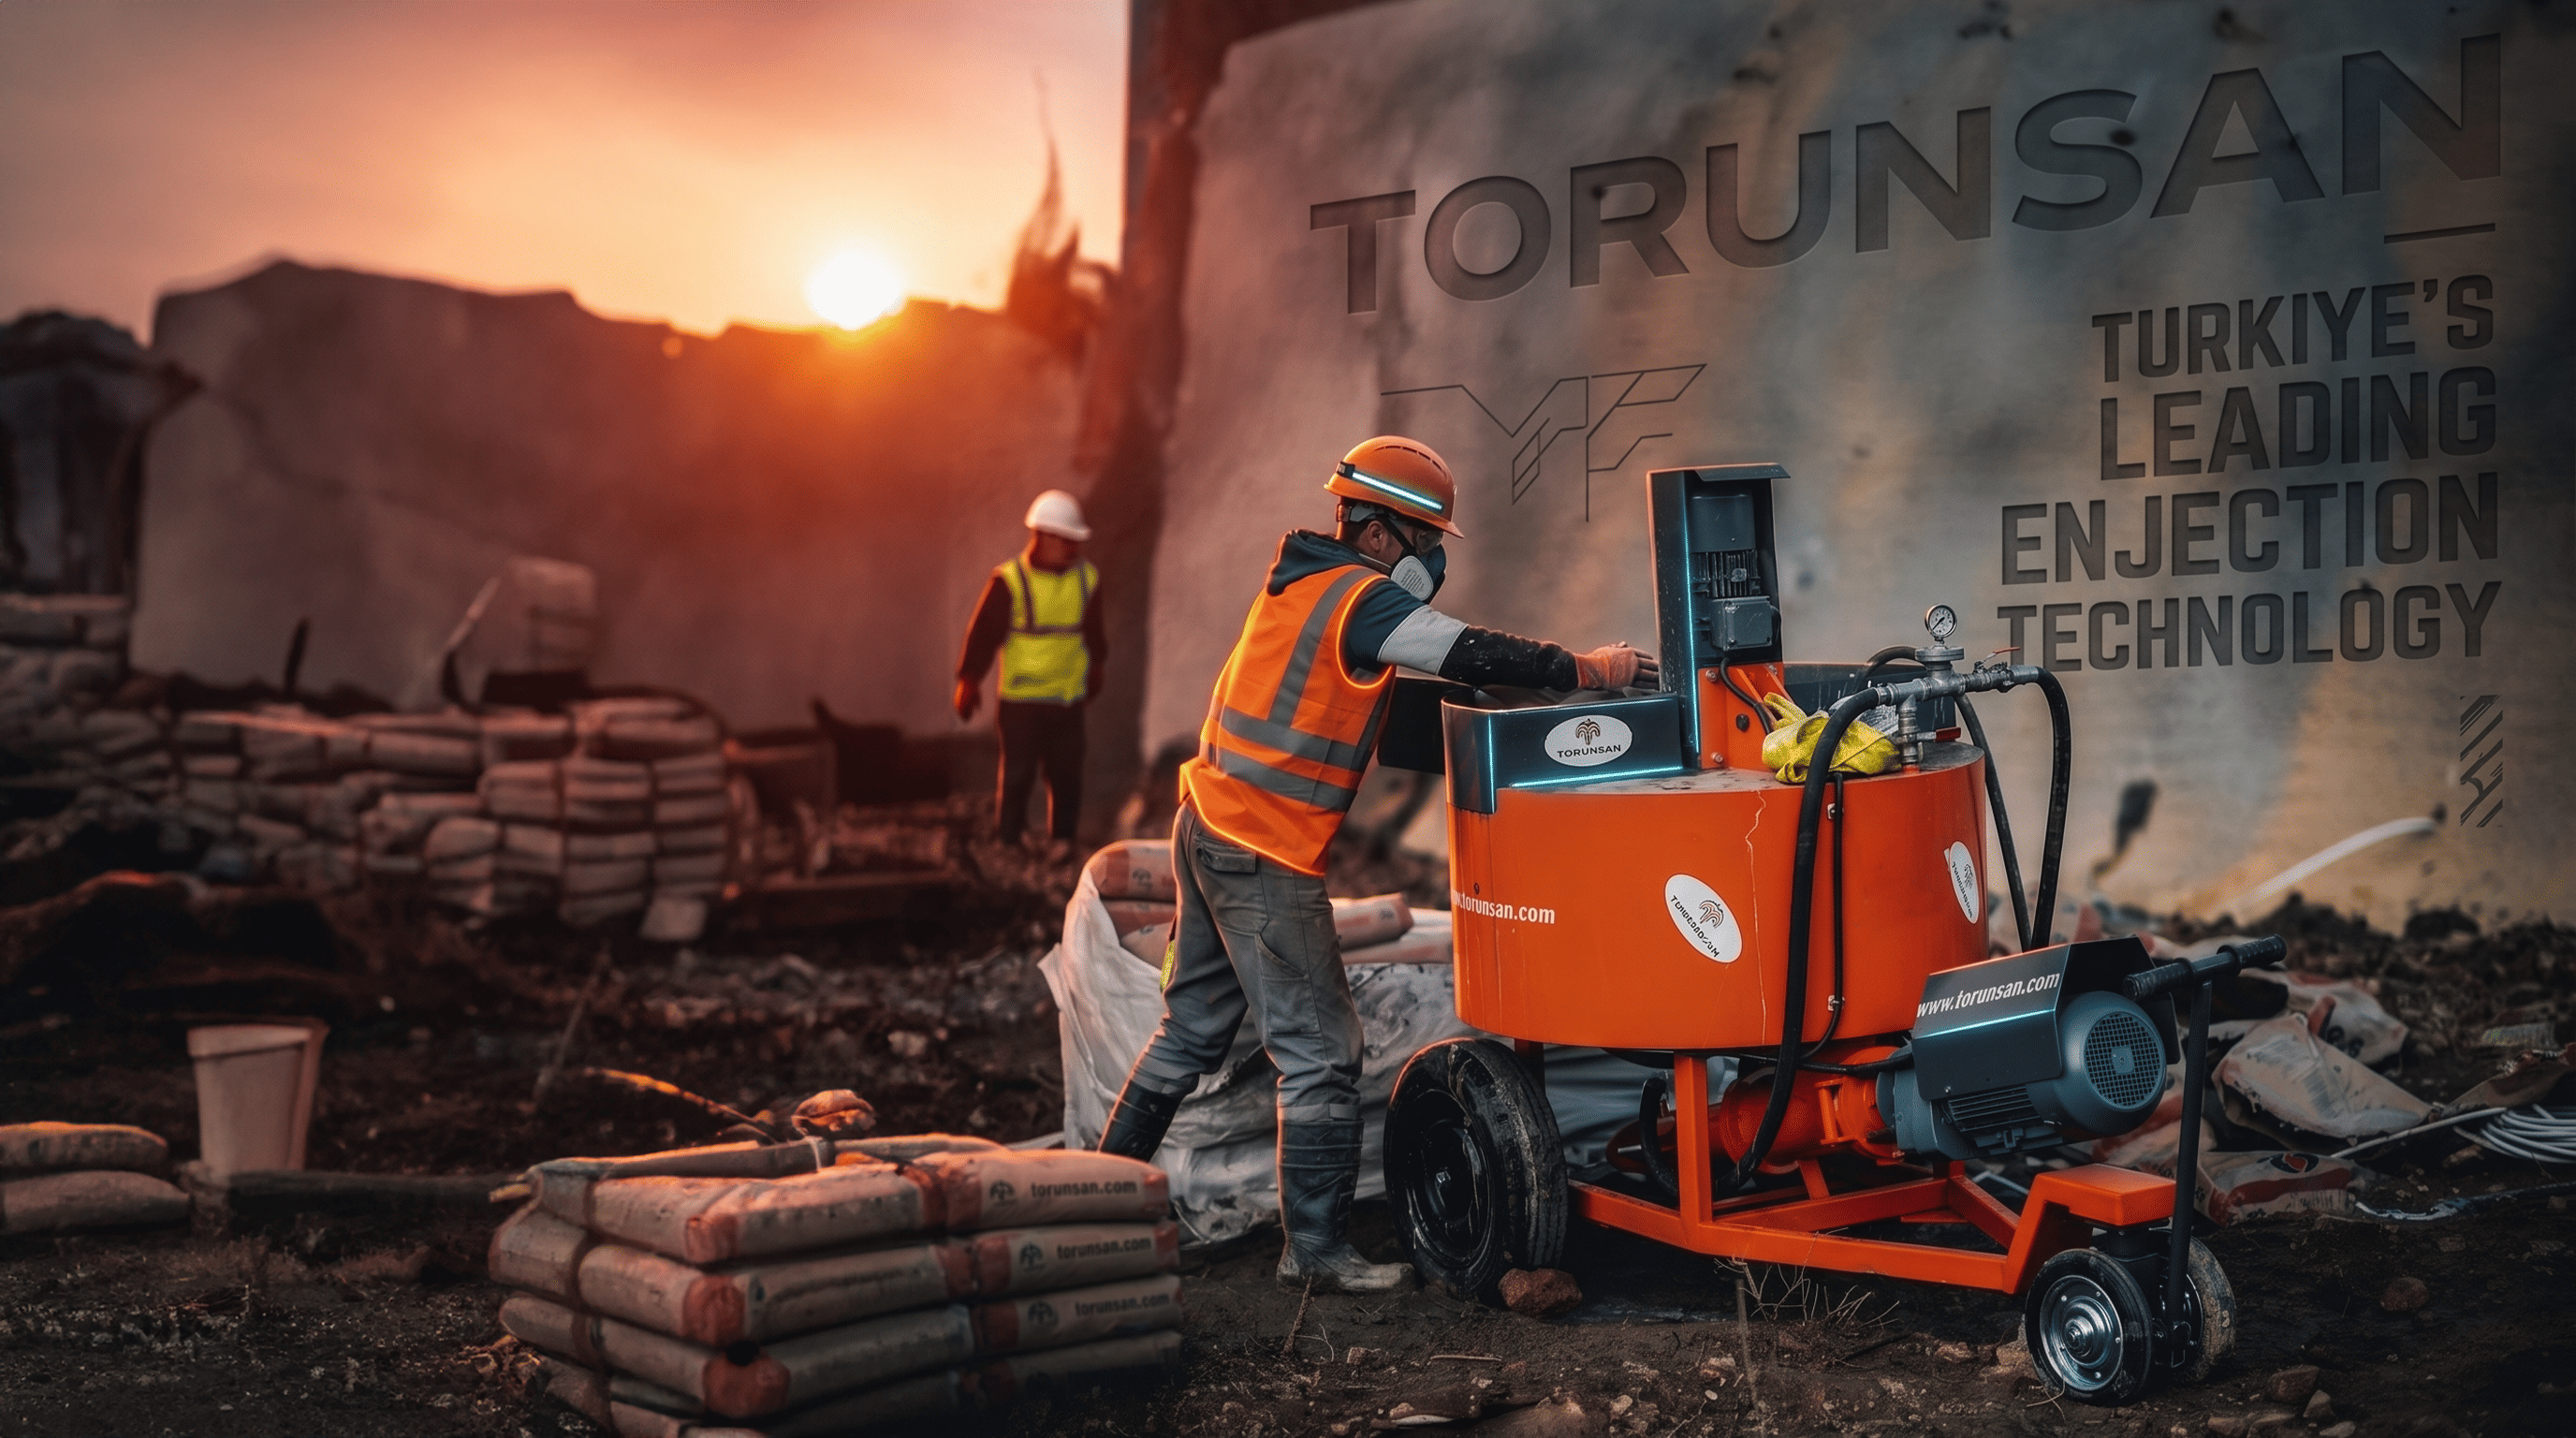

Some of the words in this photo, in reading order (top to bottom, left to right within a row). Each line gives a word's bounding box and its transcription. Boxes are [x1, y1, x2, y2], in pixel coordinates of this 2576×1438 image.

[1310, 34, 2501, 315] TORUNSAN
[2092, 275, 2494, 383] TURKIYE'S
[2101, 366, 2496, 480] LEADING
[2001, 472, 2498, 585] ENJECTION
[1997, 581, 2502, 672] TECHNOLOGY
[1557, 744, 1621, 758] TORUNSAN
[1916, 973, 2060, 1018] www.torunsan.com
[1031, 1180, 1137, 1197] torunsan.com
[1057, 1236, 1151, 1260] torunsan.com
[1075, 1292, 1170, 1316] torunsan.com
